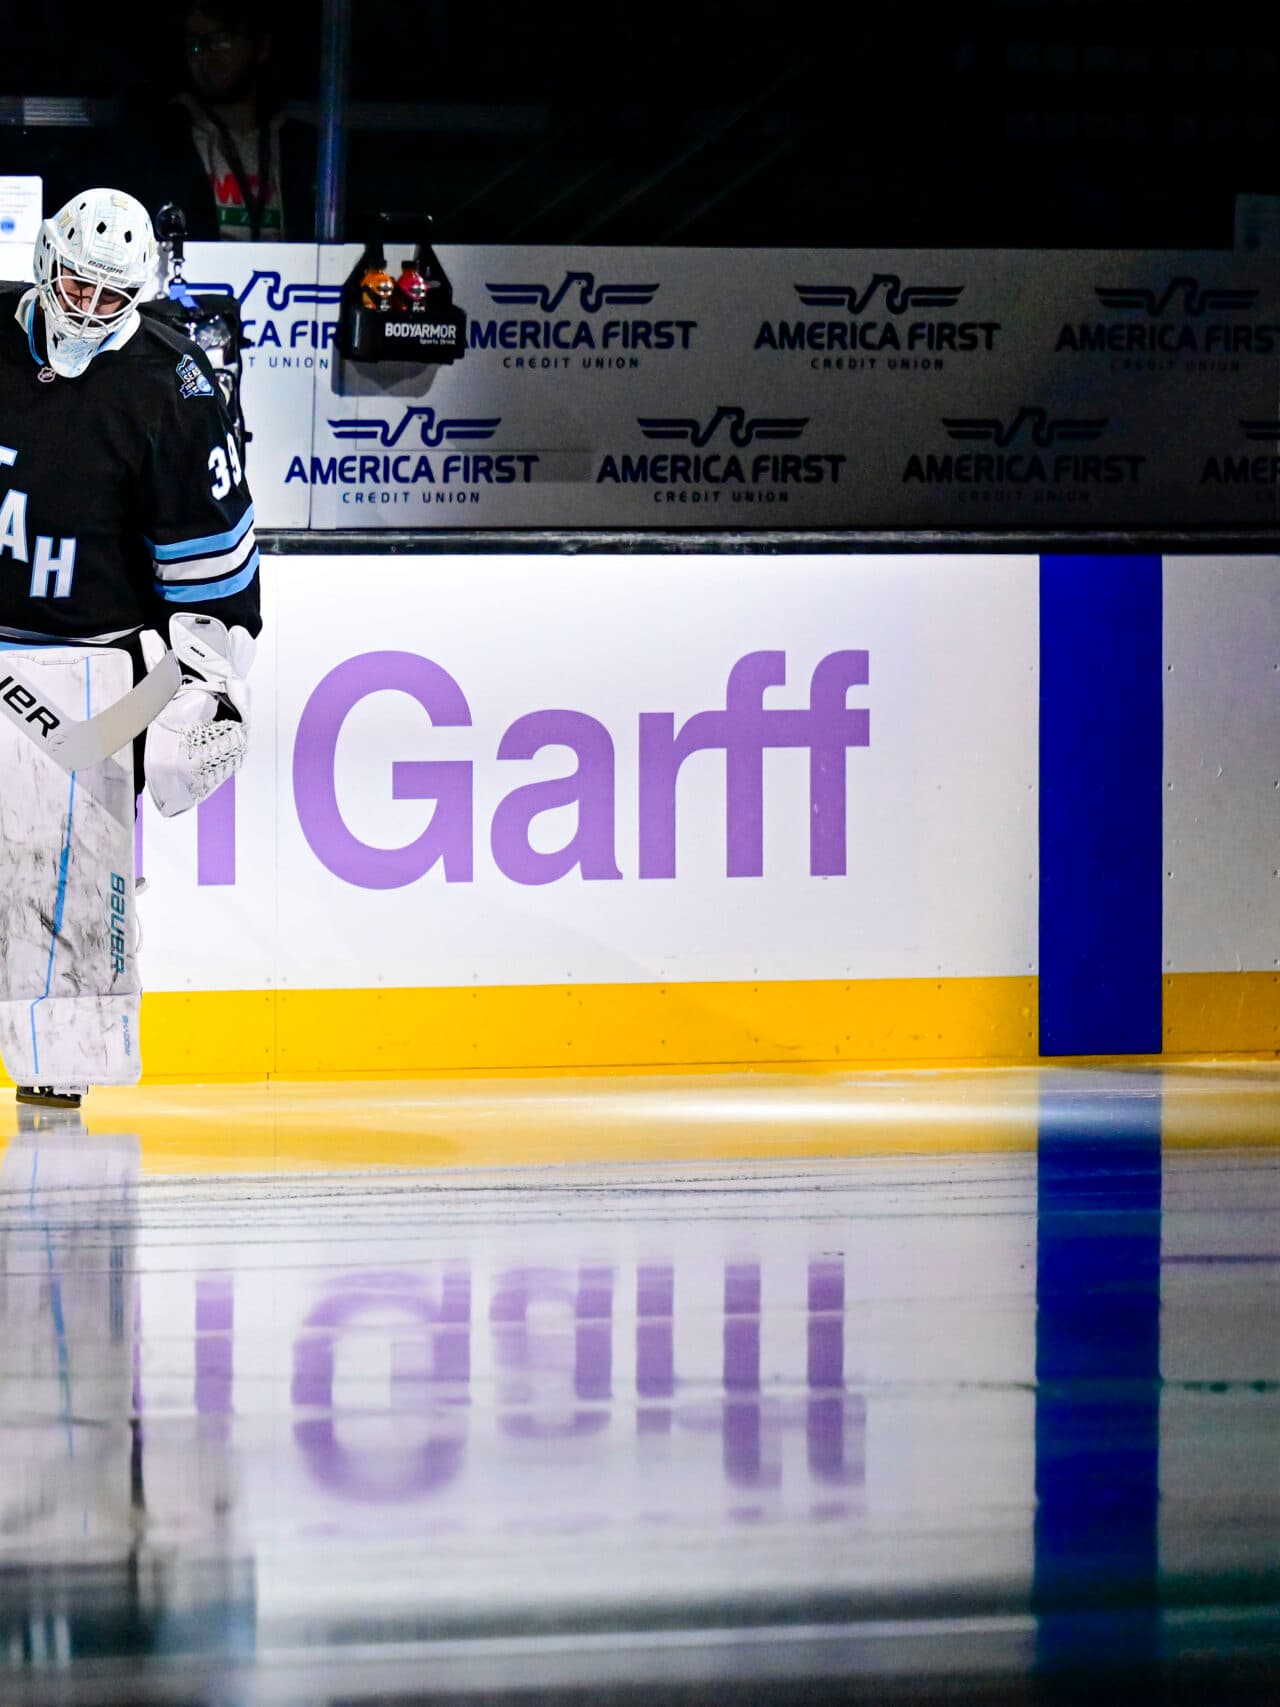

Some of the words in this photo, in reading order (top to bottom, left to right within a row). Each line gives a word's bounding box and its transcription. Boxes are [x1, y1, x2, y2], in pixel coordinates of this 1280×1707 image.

[290, 320, 340, 350] FIR
[384, 322, 457, 338] BODYARMOR
[465, 320, 596, 350] MERICA
[602, 320, 698, 350] FIRST
[754, 321, 901, 351] AMERICA
[907, 321, 1002, 352] FIRST
[1054, 323, 1199, 354] AMERICA
[269, 356, 329, 370] UNION
[503, 357, 570, 369] CREDIT
[582, 357, 639, 369] UNION
[811, 357, 877, 370] CREDIT
[888, 358, 944, 371] UNION
[208, 432, 242, 500] 39
[285, 455, 435, 485] AMERICA
[443, 455, 540, 483] FIRST
[596, 454, 746, 484] AMERICA
[752, 454, 847, 484] FIRST
[901, 454, 1047, 484] AMERICA
[1052, 454, 1146, 485] FIRST
[343, 492, 410, 503] CREDIT
[423, 492, 479, 503] UNION
[654, 491, 722, 503] CREDIT
[732, 491, 789, 504] UNION
[292, 650, 870, 890] Garff
[110, 871, 126, 975] BAUER
